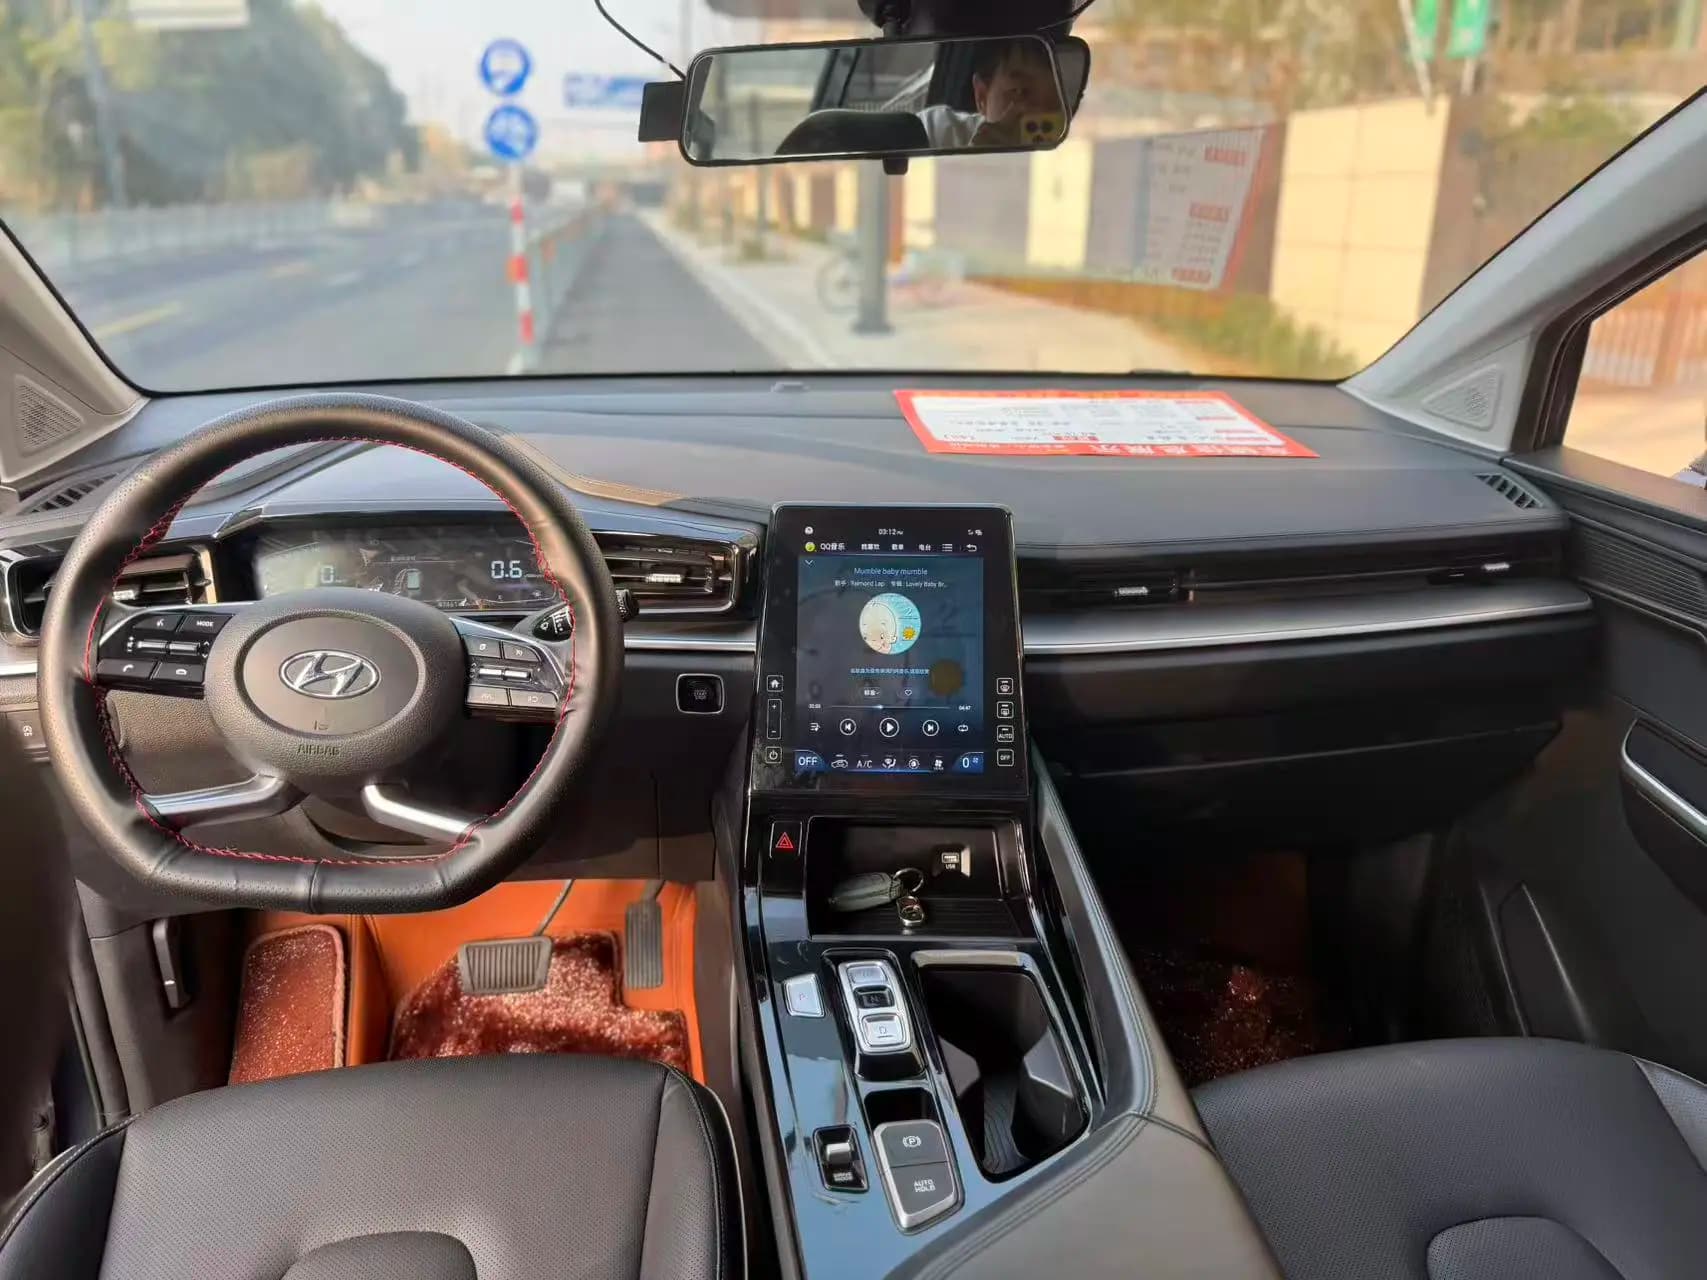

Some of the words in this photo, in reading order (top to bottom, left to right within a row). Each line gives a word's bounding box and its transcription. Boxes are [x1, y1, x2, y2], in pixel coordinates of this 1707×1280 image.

[878, 528, 896, 536] 03:12
[320, 564, 334, 584] 0
[491, 560, 523, 579] 0.6
[882, 567, 901, 577] baby
[900, 567, 928, 576] mumble
[195, 620, 215, 628] MODE
[296, 743, 341, 756] AIRBAG
[798, 755, 818, 767] OFF
[856, 759, 873, 769] A/C
[914, 1178, 934, 1187] AUTO
[915, 1184, 936, 1193] HOLD
